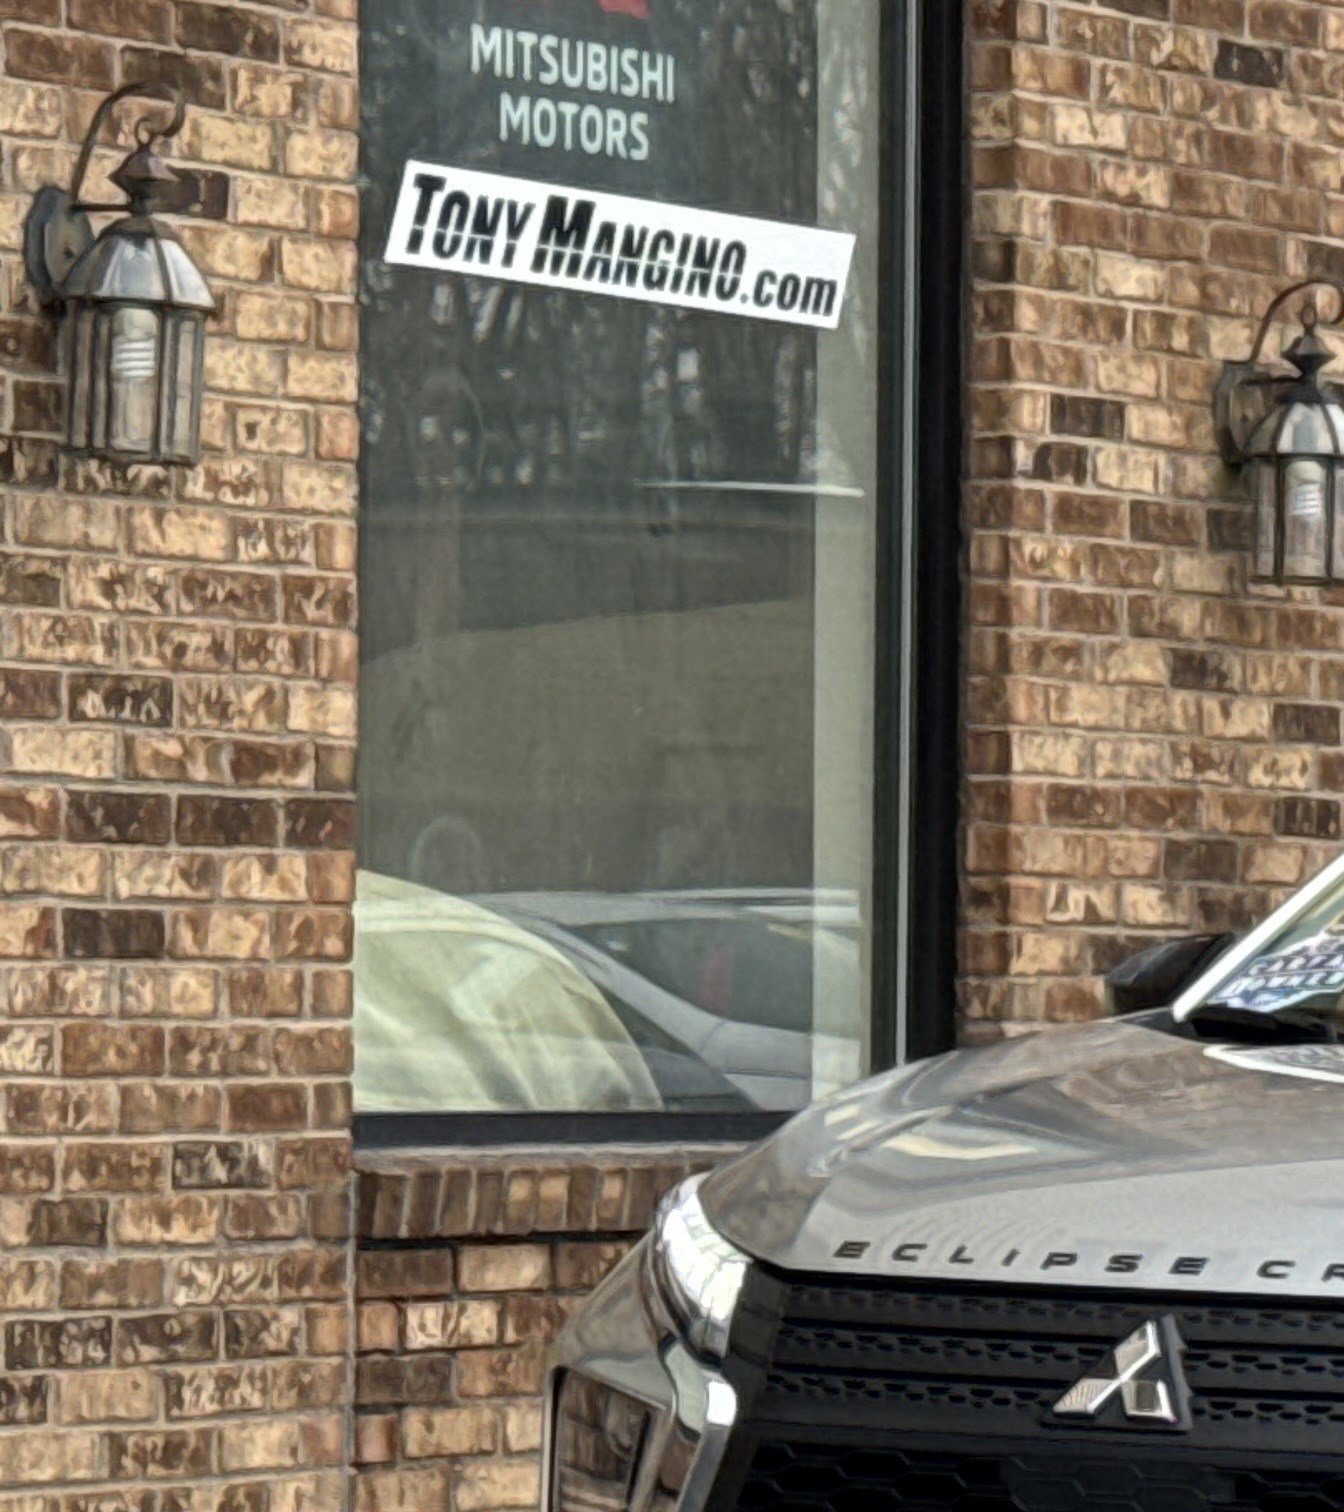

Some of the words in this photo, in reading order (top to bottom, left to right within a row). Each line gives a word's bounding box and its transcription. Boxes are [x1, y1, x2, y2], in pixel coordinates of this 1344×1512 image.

[470, 22, 676, 103] MITSUBISHI
[500, 91, 649, 161] MOTORS
[405, 172, 537, 266] TONY
[831, 1240, 1210, 1276] ECLIPSE
